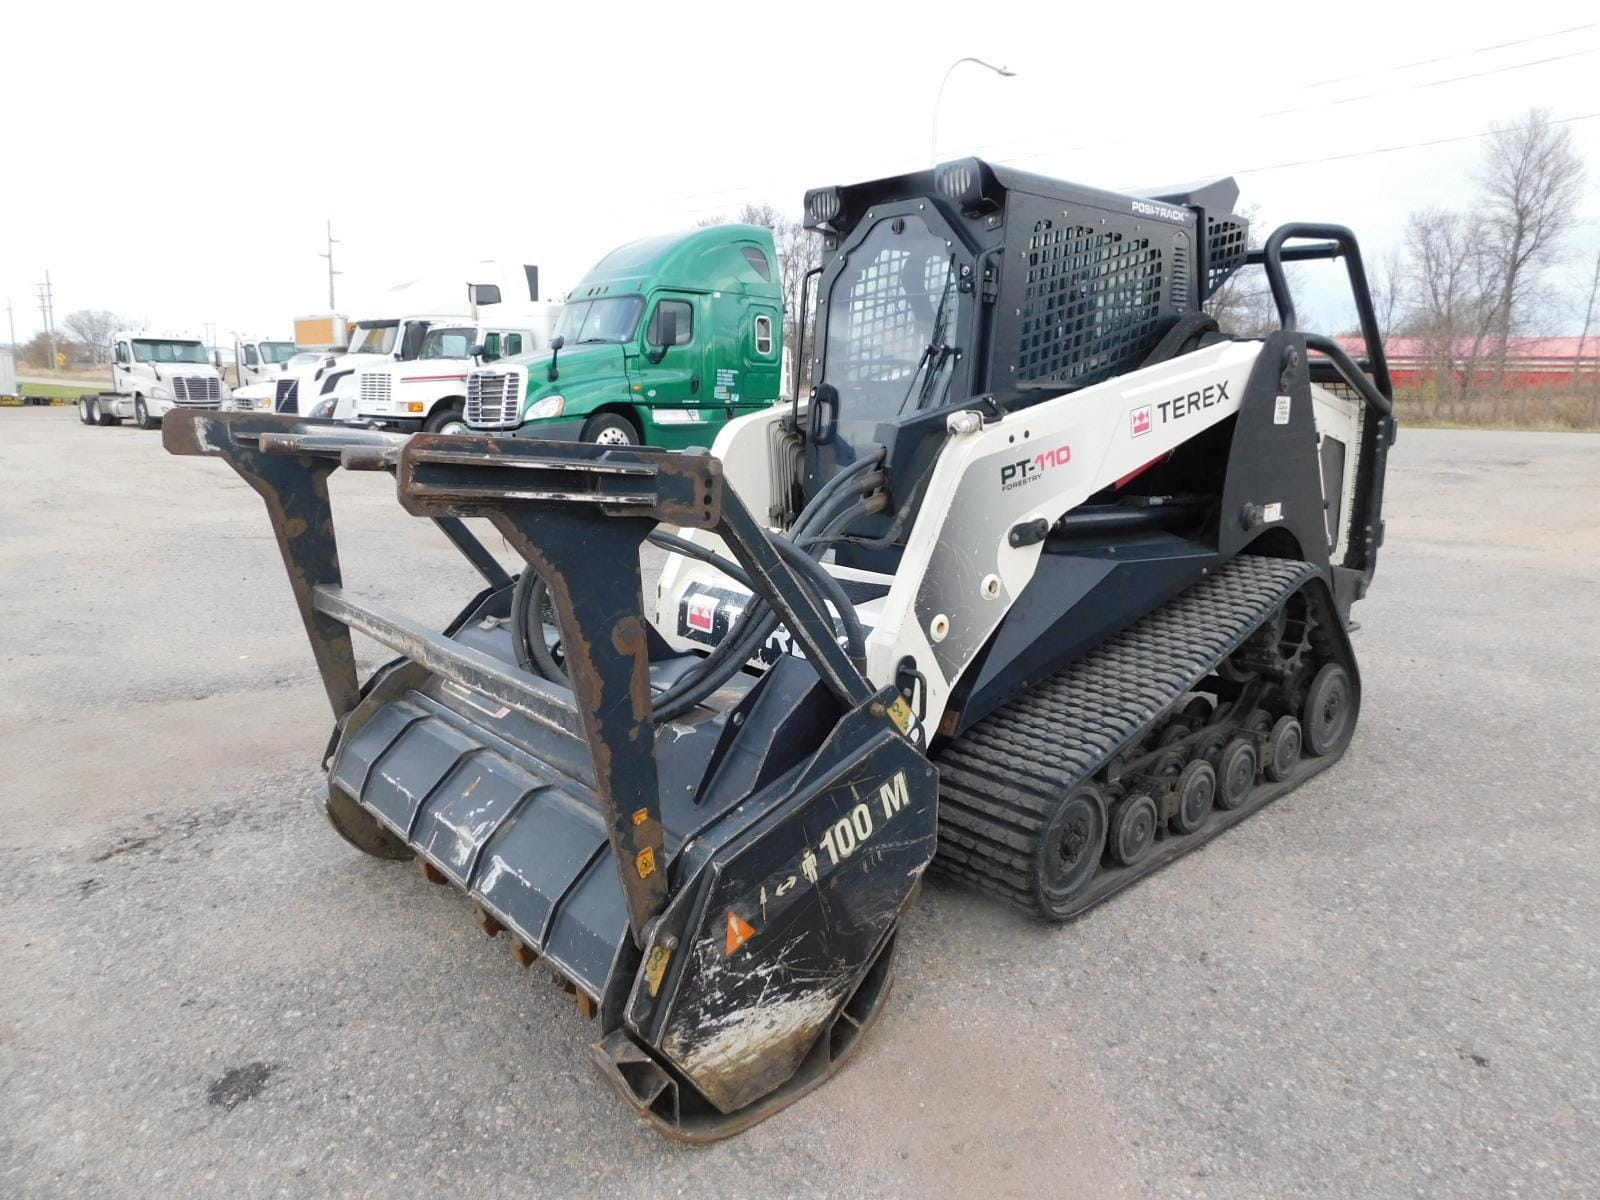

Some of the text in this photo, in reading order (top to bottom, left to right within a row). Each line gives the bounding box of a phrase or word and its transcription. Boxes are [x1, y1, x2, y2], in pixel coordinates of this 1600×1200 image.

[1157, 380, 1229, 423] TEREX
[1001, 446, 1071, 485] PT-110
[1002, 474, 1042, 491] FORESTRY
[820, 771, 910, 866] 100 M
